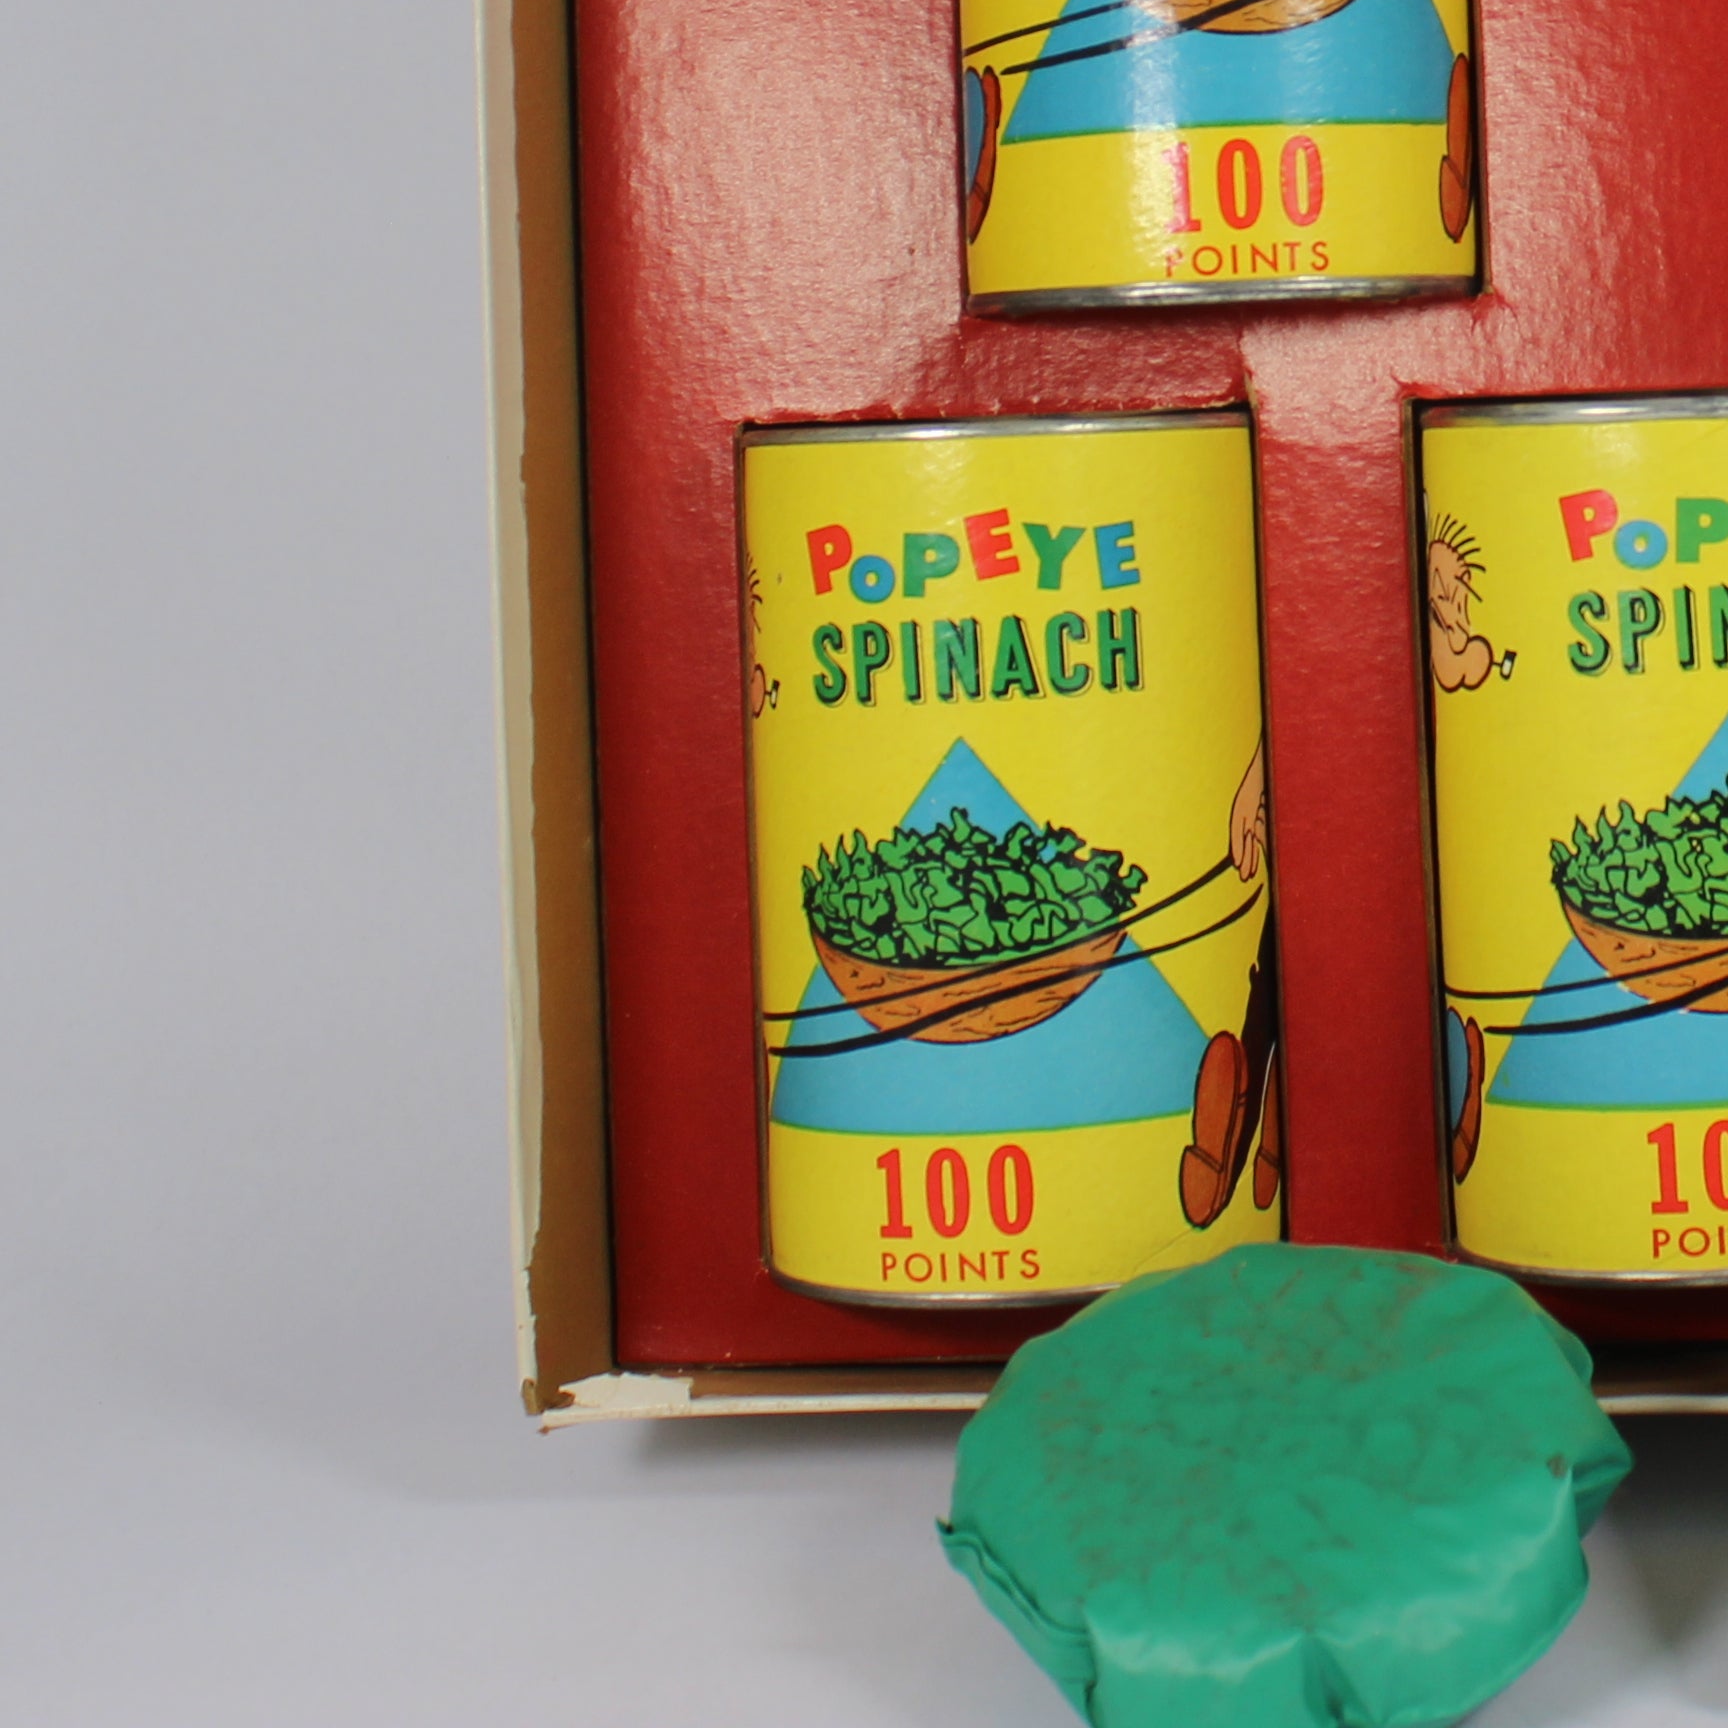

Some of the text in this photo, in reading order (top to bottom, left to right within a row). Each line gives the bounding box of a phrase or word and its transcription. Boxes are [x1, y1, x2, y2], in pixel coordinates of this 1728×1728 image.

[1162, 135, 1325, 234] 100
[1164, 241, 1330, 277] POINTS
[812, 606, 1146, 708] SPINACH
[876, 1144, 1036, 1240] 100
[880, 1249, 1041, 1283] POINTS
